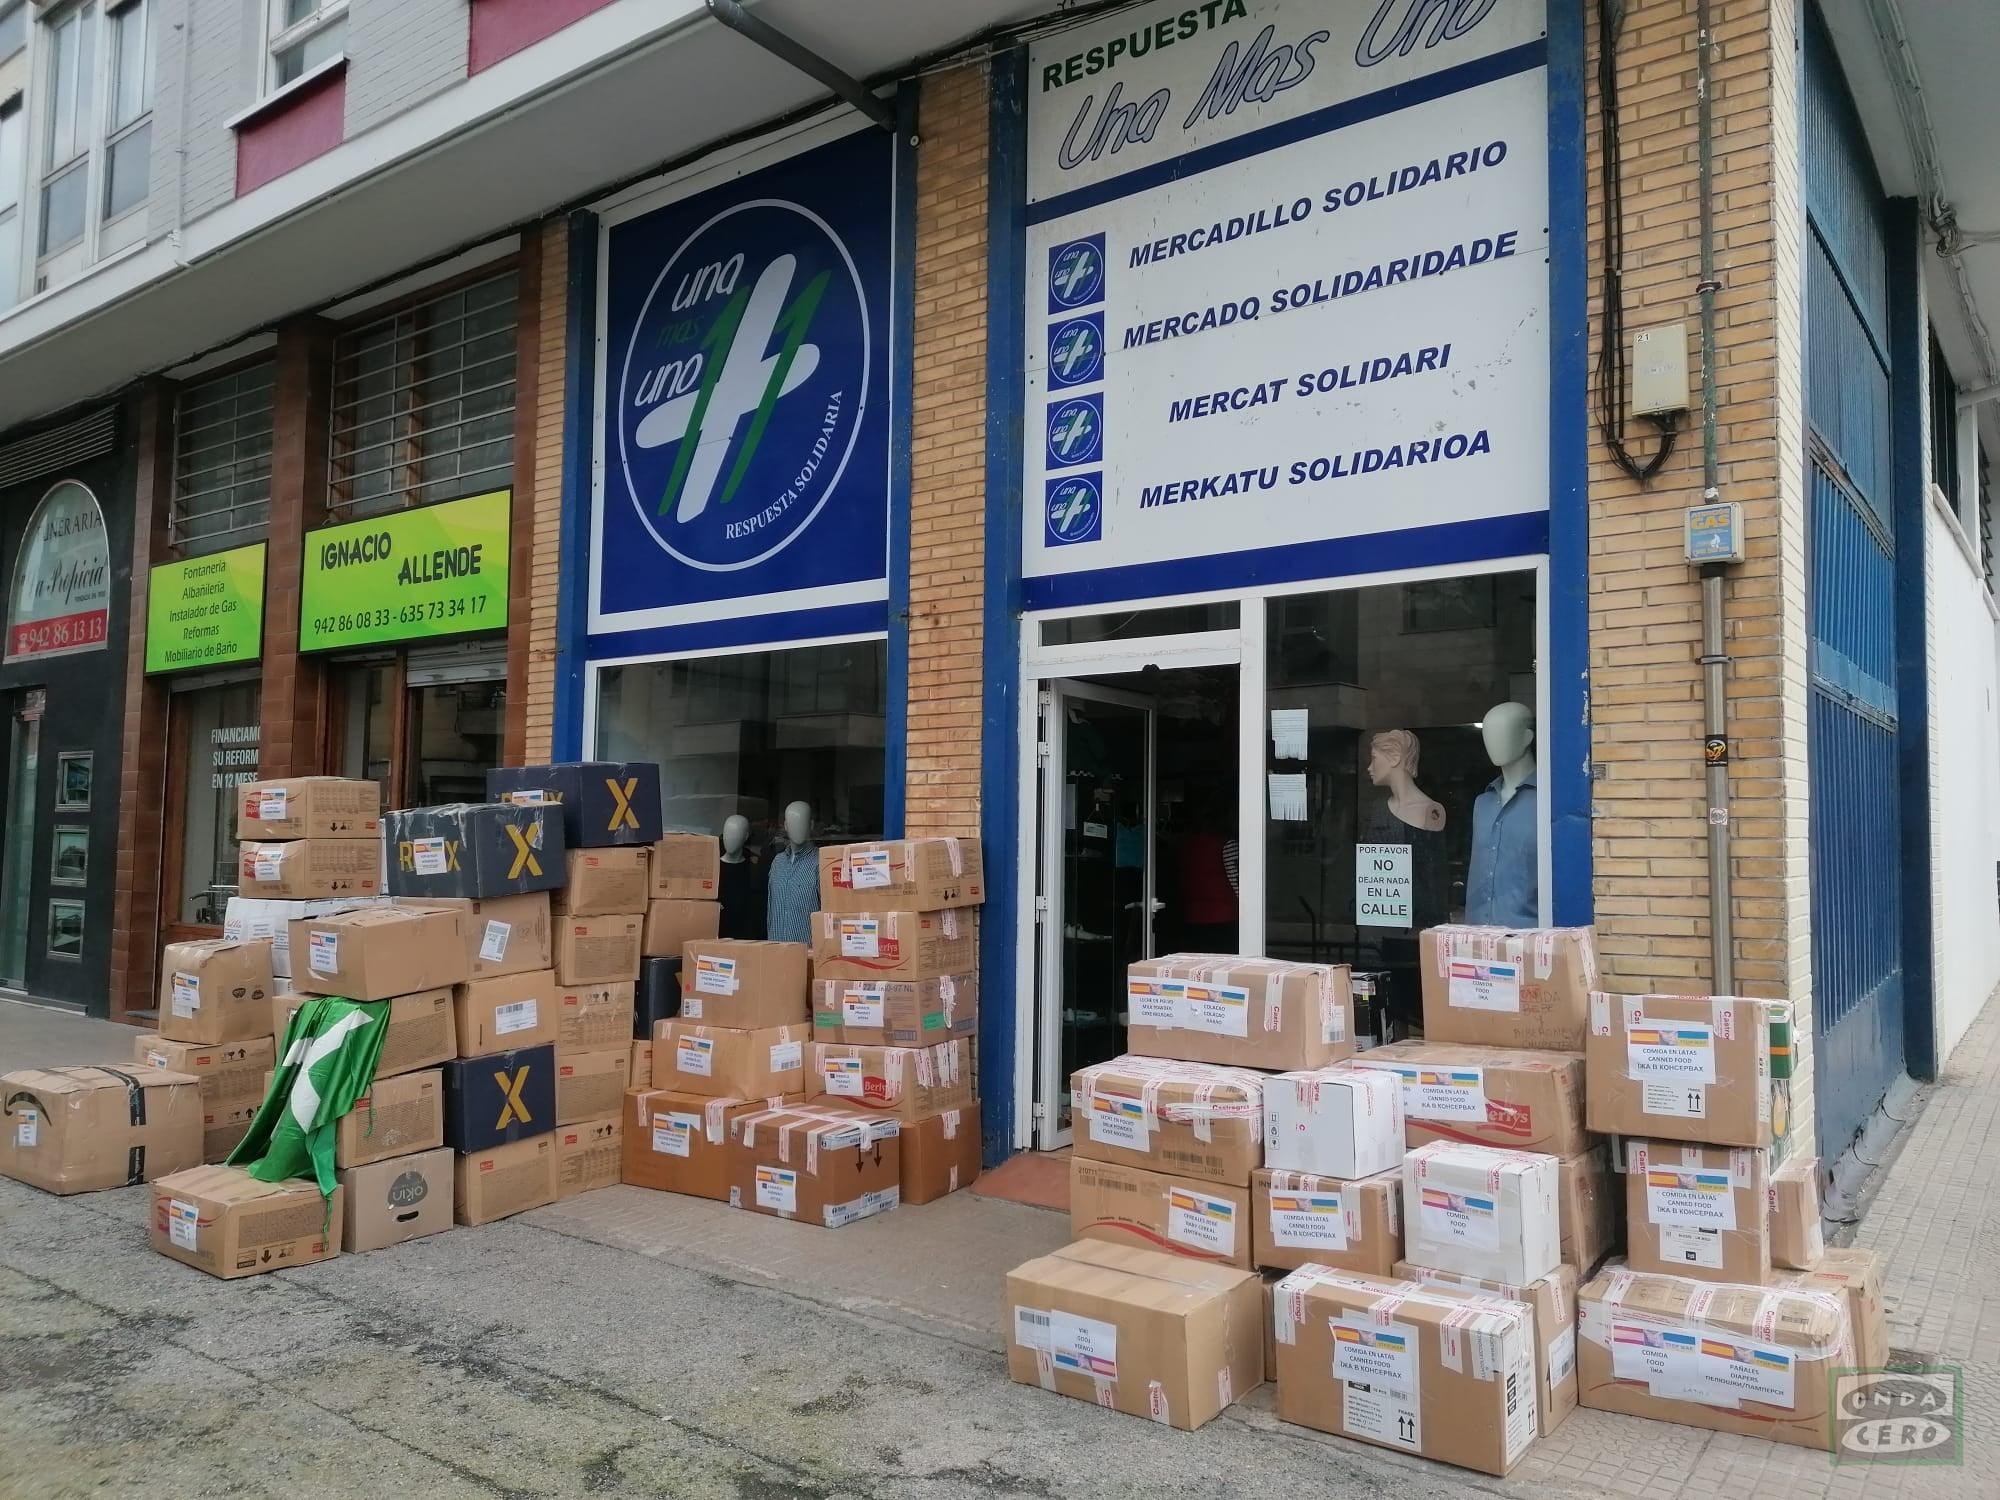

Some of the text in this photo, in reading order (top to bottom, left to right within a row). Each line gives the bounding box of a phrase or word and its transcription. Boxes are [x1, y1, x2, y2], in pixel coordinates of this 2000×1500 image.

[1042, 0, 1247, 92] RESPUESTA
[1058, 0, 1496, 170] Una Mas Uno
[1128, 140, 1508, 269] MERCADILLO SOLIDARIO
[672, 252, 745, 312] una
[1122, 230, 1518, 350] MERCADO SOLIDARIDADE
[1636, 333, 1649, 343] 21
[634, 353, 703, 407] uno
[1168, 343, 1452, 424] MERCAT SOLIDARI
[725, 390, 843, 540] RESPUESTA SOLIDARIA
[1139, 429, 1490, 509] MERKATU SOLIDARIOA
[37, 509, 103, 542] UNERARIA
[320, 531, 392, 571] IGNACIO
[397, 543, 483, 586] ALLENDE
[169, 599, 237, 623] Instalador de Gas
[314, 615, 335, 635] 942
[338, 614, 353, 632] 86
[356, 611, 371, 629] 08
[375, 608, 390, 627] 33
[400, 604, 424, 624] 635
[428, 600, 444, 620] 73
[447, 599, 465, 617] 34
[471, 595, 487, 615] 17
[29, 616, 102, 649] 942 86 13 13
[183, 624, 220, 640] Reformas
[164, 640, 238, 664] Mobiliario de Baño
[212, 751, 224, 767] SU
[211, 774, 224, 789] EN
[224, 773, 233, 788] 12
[1359, 846, 1409, 855] POR FAVOR
[1373, 859, 1394, 871] NO
[1358, 876, 1410, 885] DEJAR NADA
[1367, 887, 1401, 898] EN LA
[1360, 903, 1408, 916] CALLE
[392, 1183, 424, 1202] okin
[1661, 1191, 1686, 1199] COMIDA
[1687, 1192, 1697, 1200] EN
[1667, 1199, 1712, 1209] CANNED FOOD
[1283, 1214, 1305, 1222] COMIDA
[1446, 1211, 1470, 1221] COMIDA
[1450, 1220, 1467, 1228] FOOD
[1343, 1346, 1395, 1361] COMIDA EN LATAS
[1641, 1349, 1668, 1359] COMIDA
[1349, 1355, 1391, 1369] CANNED FOOD
[1646, 1358, 1665, 1367] FOOD
[1729, 1363, 1760, 1375] PAÑALES
[1730, 1373, 1759, 1383] DIAPERS
